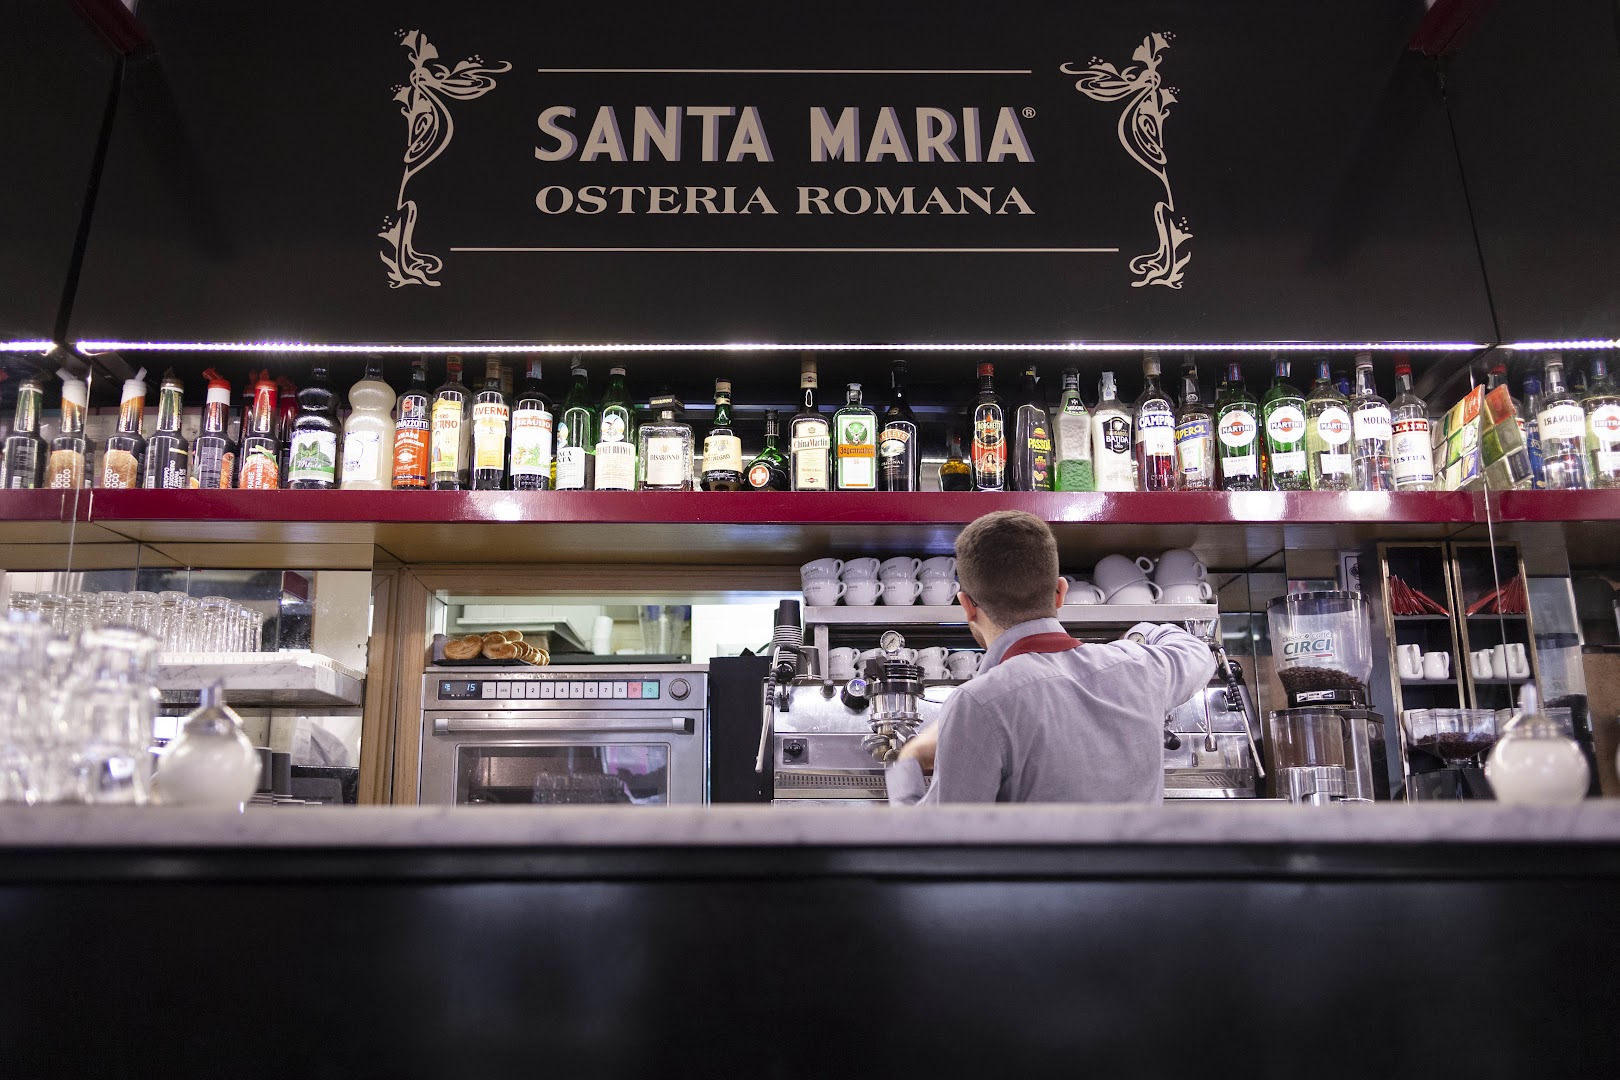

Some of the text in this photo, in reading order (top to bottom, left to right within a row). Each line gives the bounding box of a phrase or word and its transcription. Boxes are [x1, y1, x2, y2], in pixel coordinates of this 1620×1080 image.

[534, 105, 774, 162] SANTA
[535, 185, 1036, 215] OSTERIA ROMANA
[474, 406, 509, 417] AVERNA
[1221, 424, 1253, 434] MARTINI
[1270, 421, 1302, 430] MARTINI
[1320, 422, 1349, 430] MARTINI
[1283, 639, 1331, 655] CIRCI
[466, 683, 476, 692] 15
